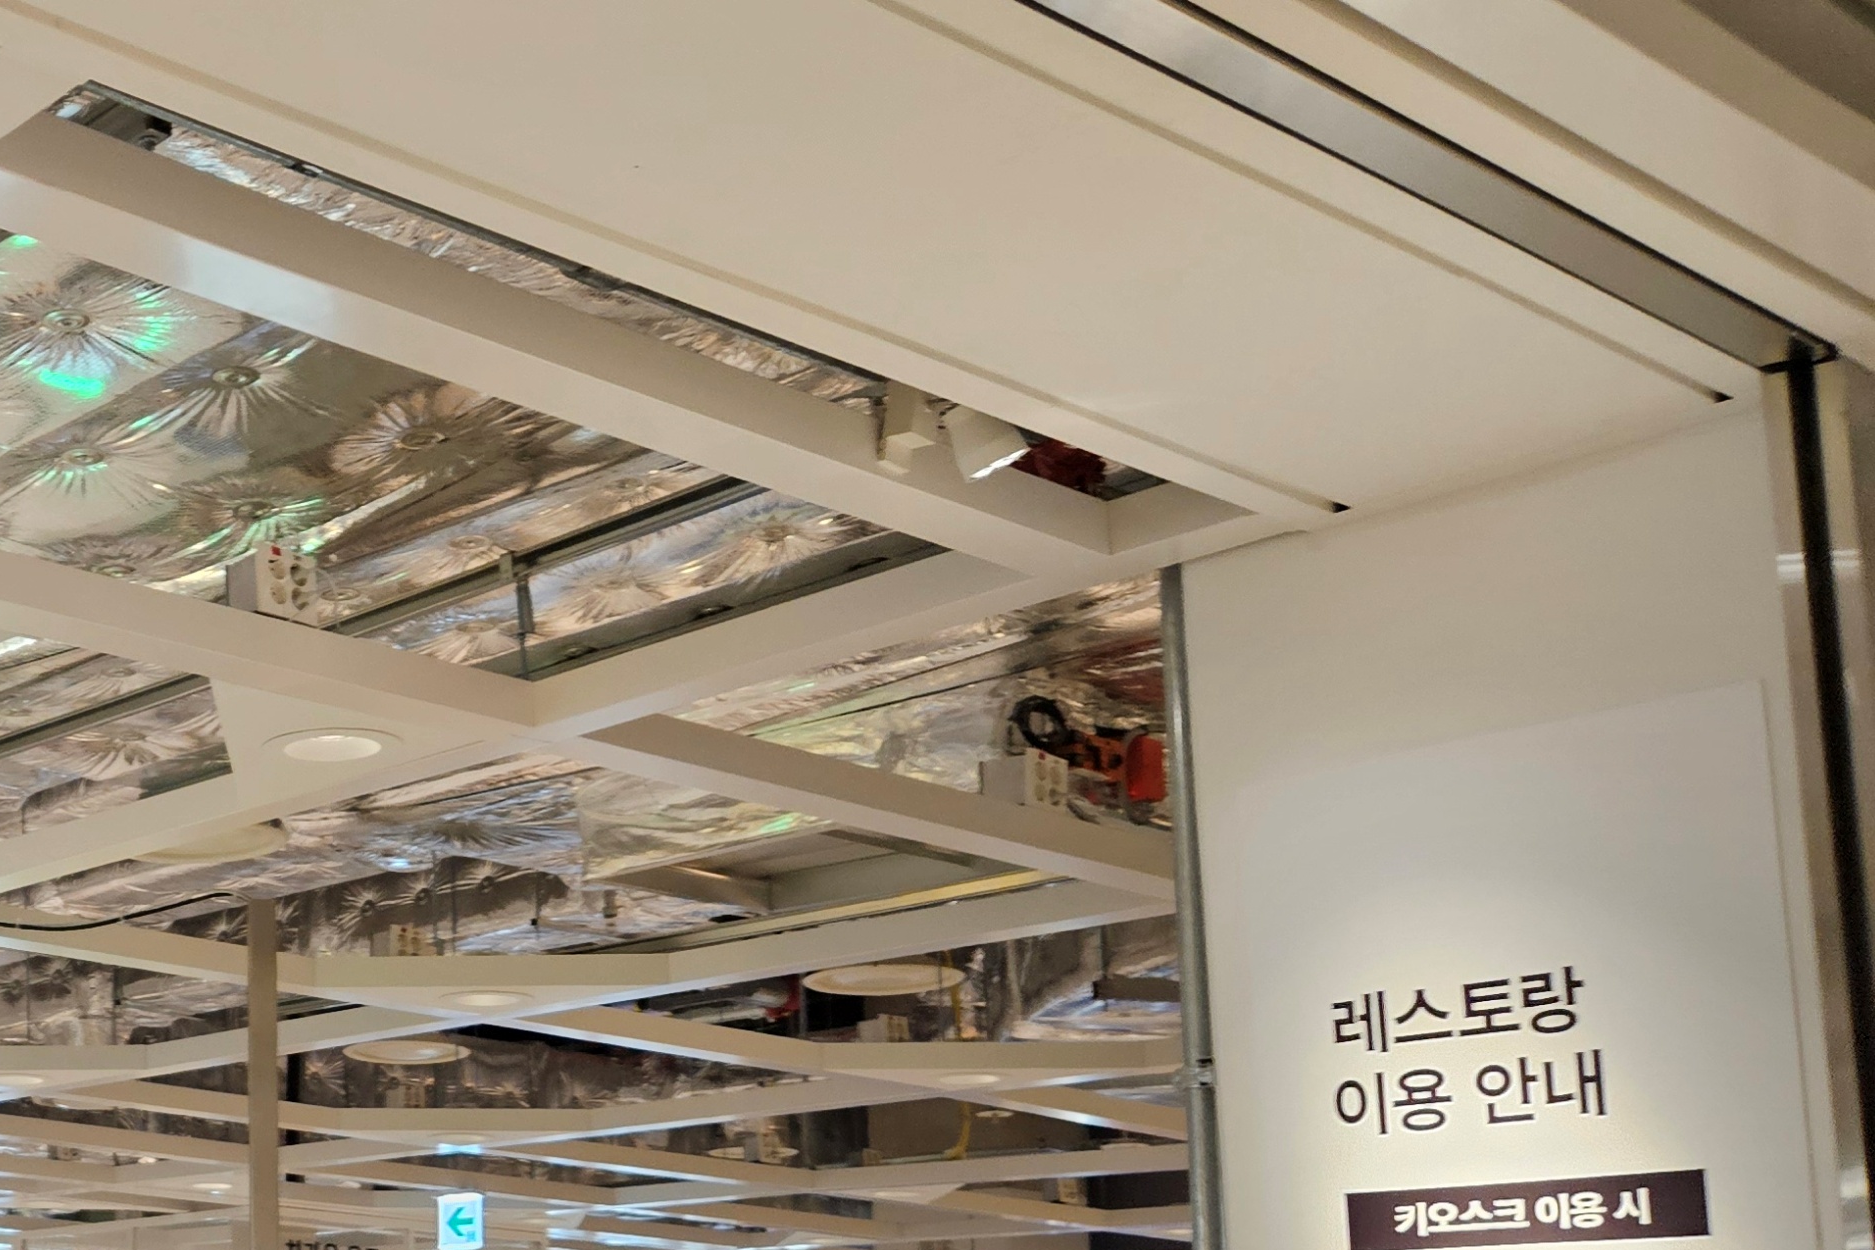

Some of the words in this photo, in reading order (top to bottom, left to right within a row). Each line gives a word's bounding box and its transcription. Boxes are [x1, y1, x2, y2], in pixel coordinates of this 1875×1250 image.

[1330, 966, 1585, 1052] 레스토랑
[1335, 1068, 1453, 1134] 이용
[1476, 1049, 1607, 1124] 안내
[1393, 1198, 1530, 1237] 키오스크
[1534, 1191, 1608, 1229] 이용
[1612, 1187, 1652, 1225] 시
